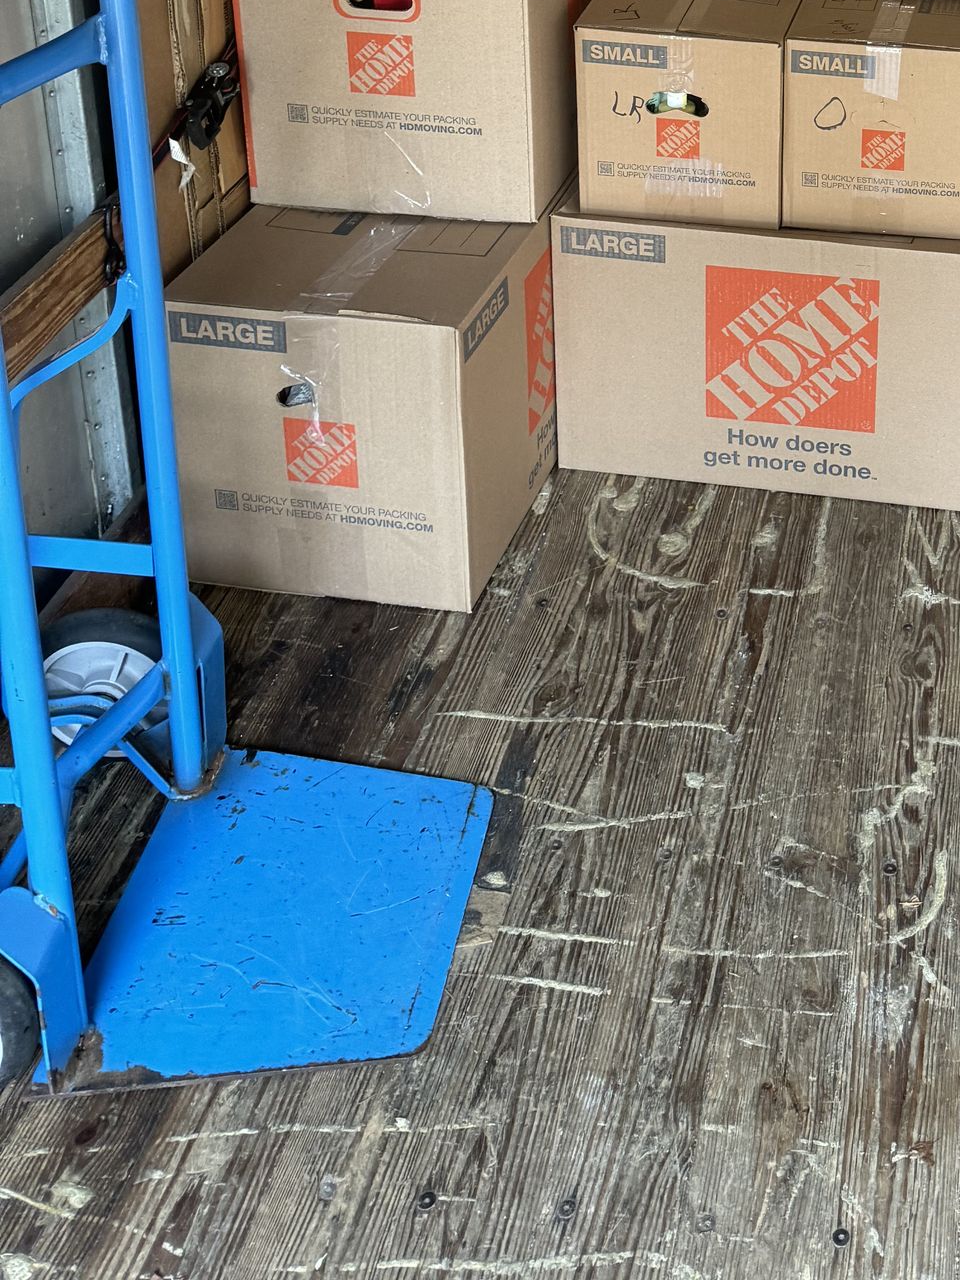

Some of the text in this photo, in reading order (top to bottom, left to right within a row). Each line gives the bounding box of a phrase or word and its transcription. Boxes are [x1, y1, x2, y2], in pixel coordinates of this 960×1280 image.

[354, 39, 381, 62] THE
[590, 45, 659, 64] SMALL
[350, 35, 414, 93] HOME
[376, 58, 415, 95] DEPOT
[799, 54, 867, 74] SMALL
[311, 106, 476, 126] QUICKLY ESTIMATE YOUR PACKING
[312, 116, 482, 136] SUPPLY NEEDS AT HDMOVING.COM
[657, 119, 700, 157] HOME
[661, 122, 679, 138] THE
[866, 134, 885, 150] THE
[673, 136, 700, 158] DEPOT
[862, 131, 906, 168] HOME
[878, 146, 904, 169] DEPOT
[617, 162, 751, 179] QUICKLY ESTIMATE YOUR PACKING
[617, 170, 648, 179] SUPPLY
[650, 173, 676, 181] NEEDS
[688, 176, 756, 187] HDMOVING.COM
[821, 173, 956, 189] QUICKLY ESTIMATE YOUR PACKING
[821, 181, 851, 190] SUPPLY
[853, 184, 880, 193] NEEDS
[892, 187, 960, 197] HDMOVING.COM
[570, 231, 655, 257] LARGE
[466, 287, 506, 351] LARGE
[721, 286, 796, 348] THE
[180, 317, 275, 346] LARGE
[706, 276, 880, 420] HOME
[772, 336, 878, 426] DEPOT
[287, 423, 356, 482] HOME
[726, 428, 852, 457] How doers
[316, 447, 357, 484] DEPOT
[703, 449, 741, 470] get
[747, 455, 807, 473] more
[242, 492, 427, 521] QUICKLY ESTIMATE YOUR PACKING
[242, 503, 434, 533] SUPPLY NEEDS AT HDMOVING.COM
